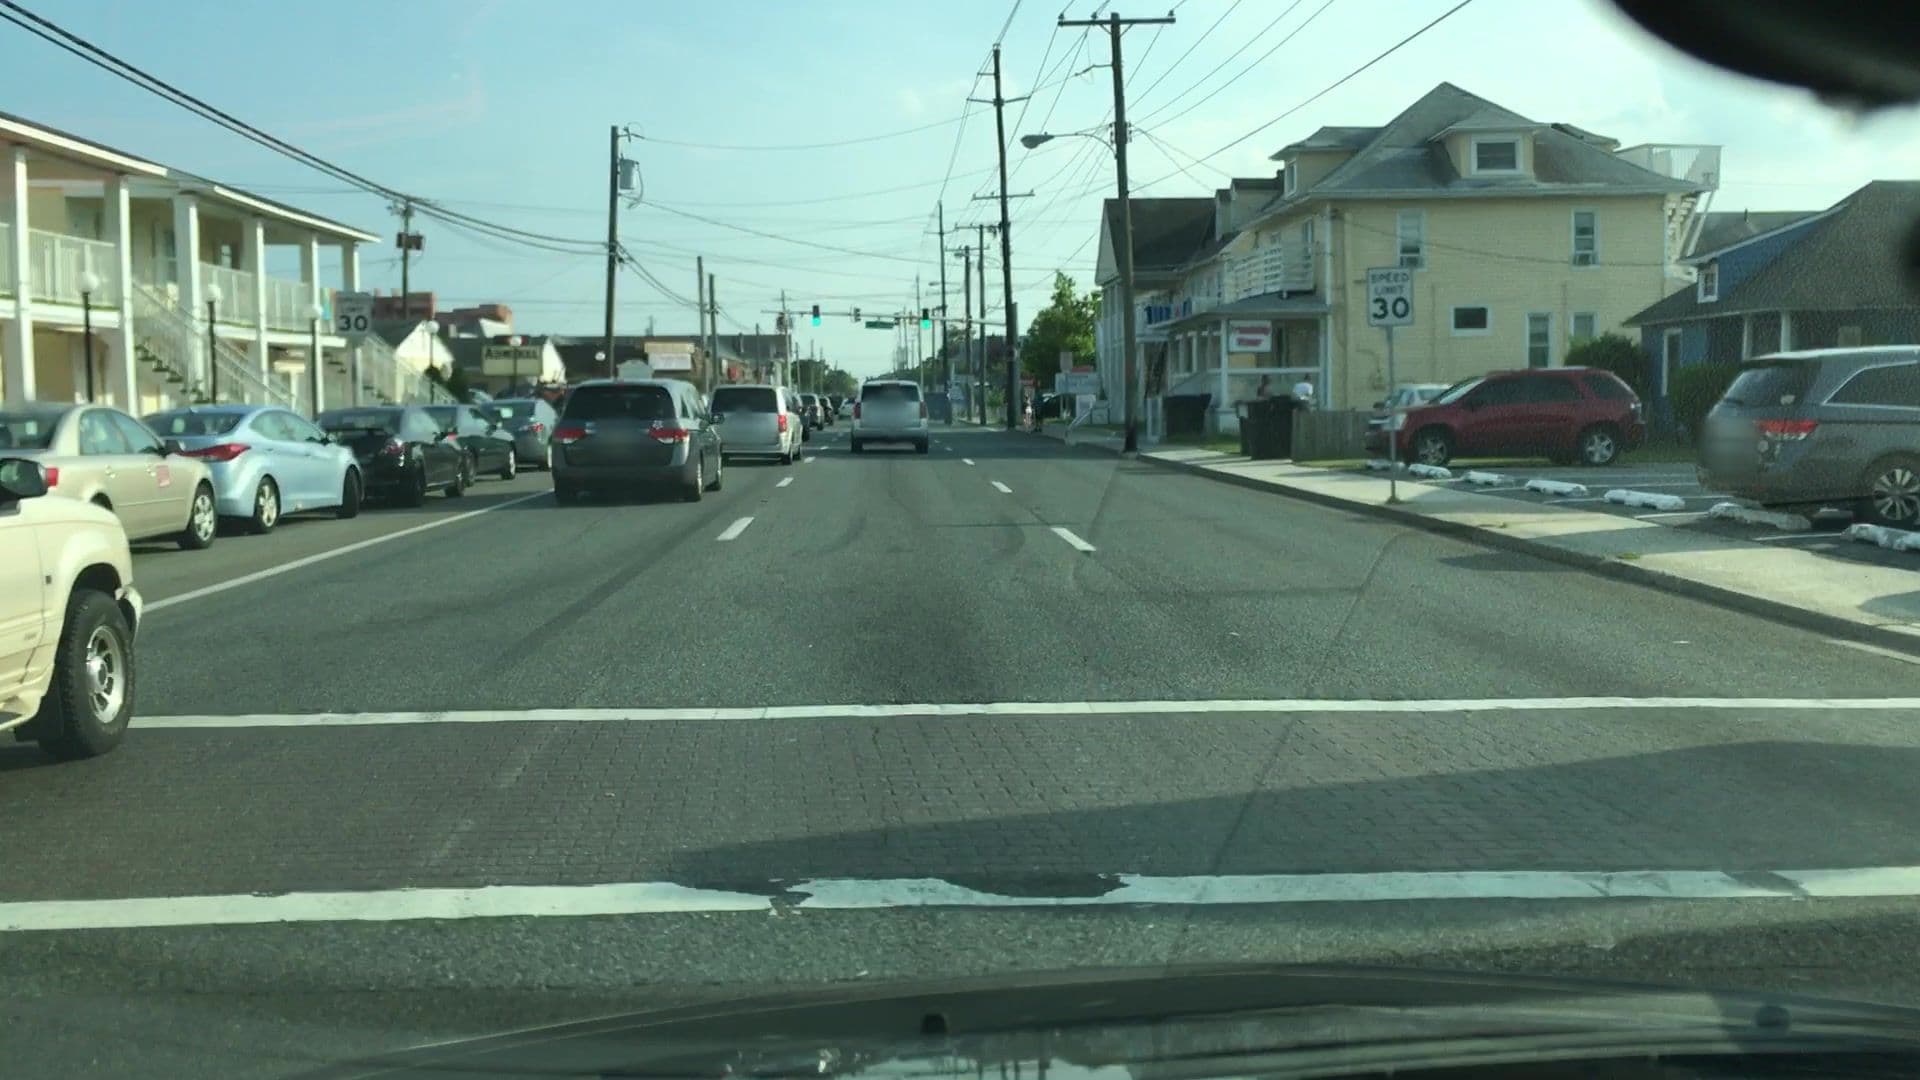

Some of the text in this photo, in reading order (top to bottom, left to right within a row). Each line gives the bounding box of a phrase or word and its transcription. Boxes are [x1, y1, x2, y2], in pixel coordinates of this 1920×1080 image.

[1371, 272, 1410, 284] SPEED
[1375, 285, 1404, 296] LIMIT
[1372, 297, 1410, 319] 30
[339, 315, 368, 331] 30
